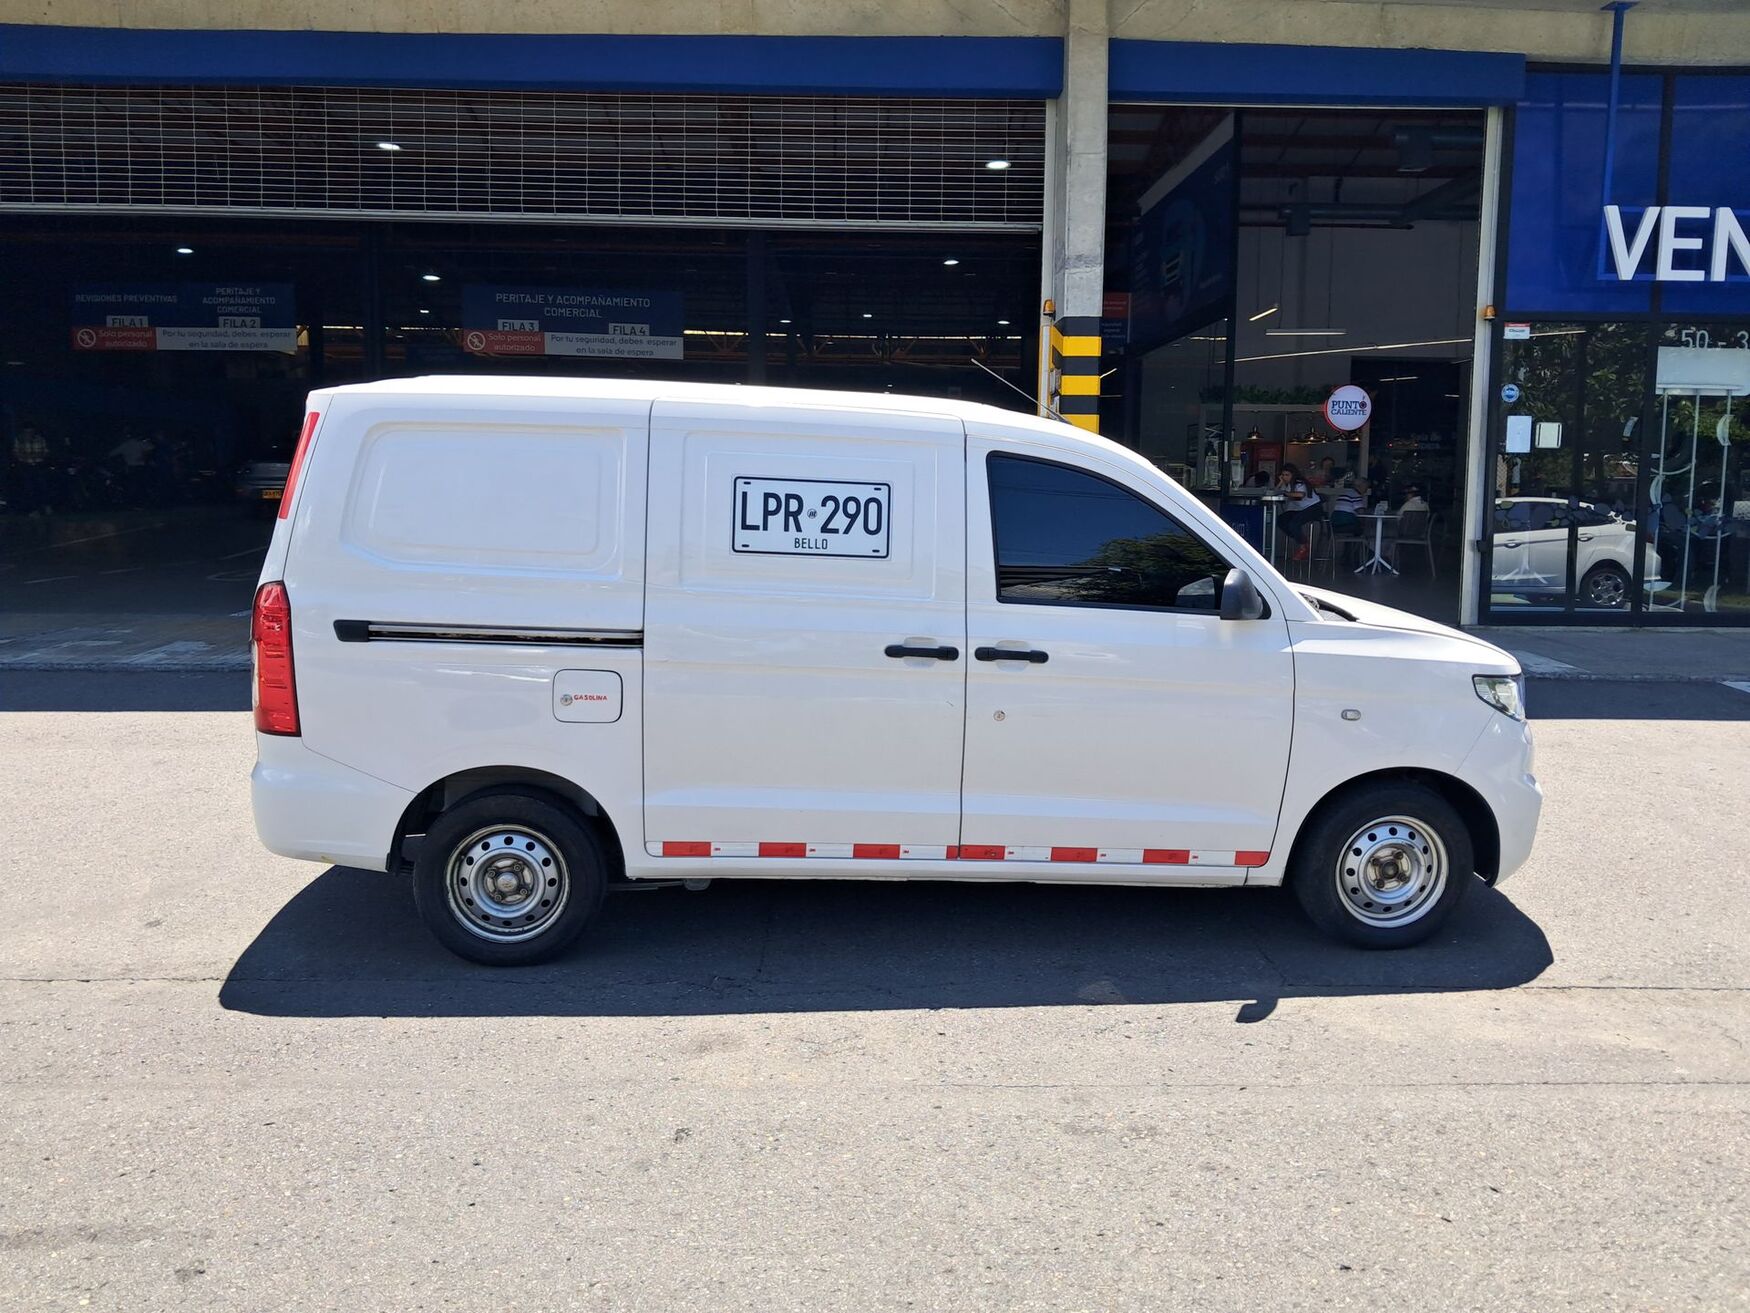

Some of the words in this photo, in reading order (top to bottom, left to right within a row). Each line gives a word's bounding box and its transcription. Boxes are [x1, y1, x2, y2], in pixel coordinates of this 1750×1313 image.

[1603, 205, 1750, 282] VEN
[75, 294, 122, 303] REVISIONES
[123, 294, 177, 303] PREVENTIVAS
[202, 295, 276, 305] ACOMPAÑAMIENTO
[496, 293, 545, 304] PERITAJE
[547, 294, 554, 304] Y
[556, 294, 651, 308] ACOMPAÑAMIENTO
[217, 305, 262, 314] COMERCIAL
[544, 307, 602, 318] COMERCIAL
[112, 318, 136, 328] FILA
[138, 318, 144, 328] 1
[223, 318, 247, 328] FILA
[249, 319, 256, 328] 2
[502, 321, 525, 332] FILA
[528, 322, 535, 332] 3
[613, 325, 637, 335] FILA
[639, 326, 646, 336] 4
[488, 333, 506, 341] Solo
[507, 335, 542, 343] personal
[551, 334, 564, 342] Por
[647, 339, 677, 347] esperar
[1681, 329, 1709, 349] 50
[241, 342, 268, 350] espera
[494, 344, 536, 352] autorizado
[1331, 400, 1368, 409] PUNTO
[740, 491, 804, 533] LPR
[820, 495, 883, 536] 290
[794, 537, 828, 550] BELLO
